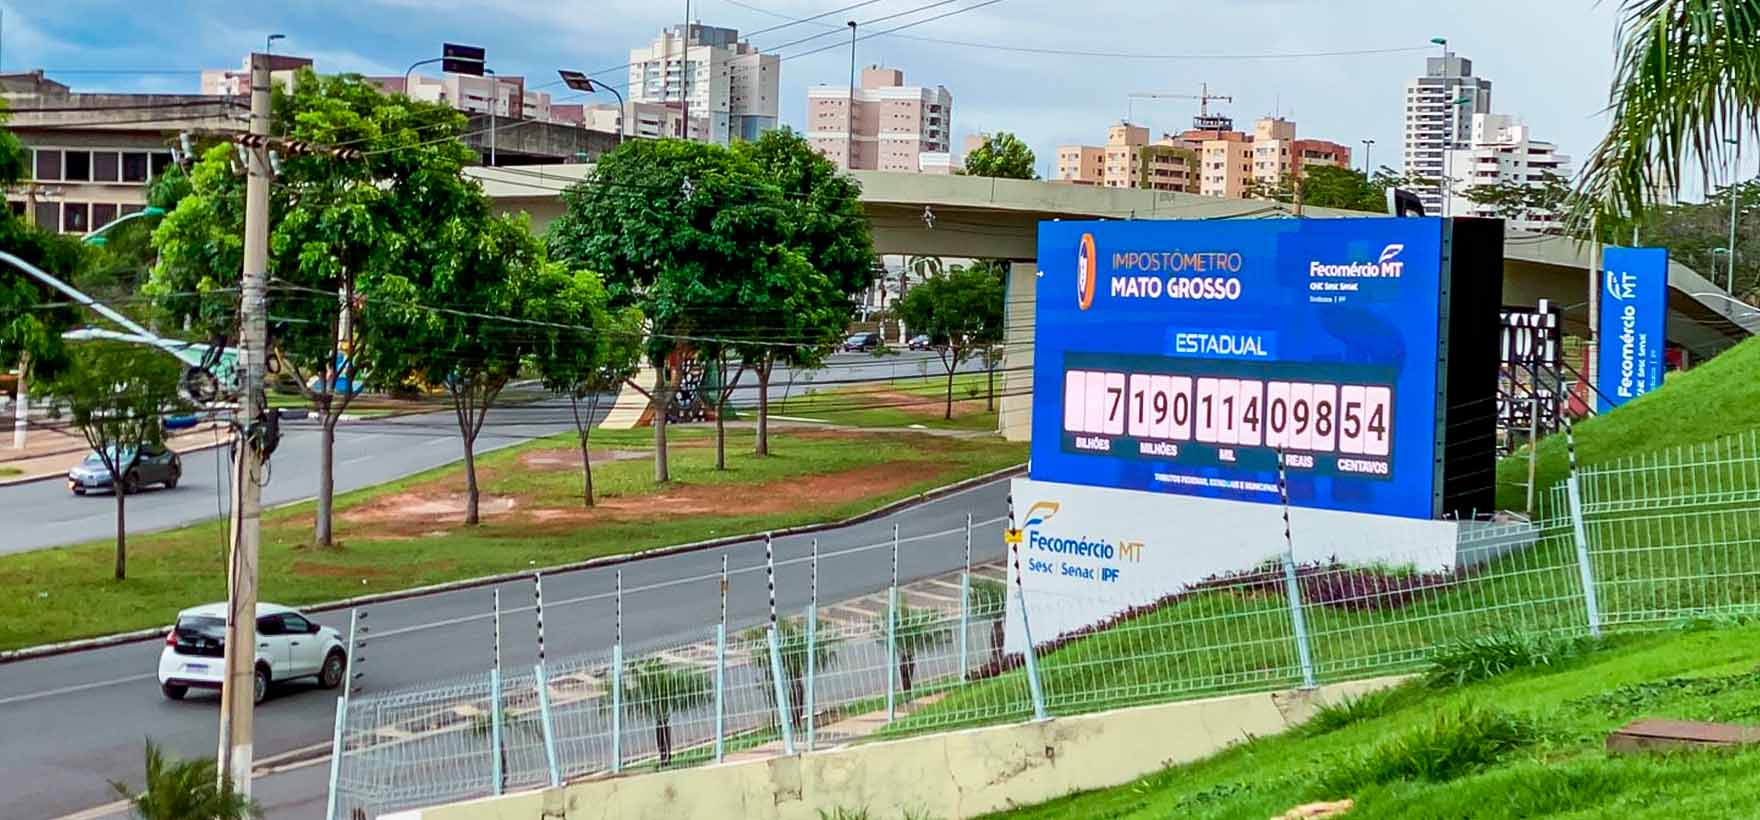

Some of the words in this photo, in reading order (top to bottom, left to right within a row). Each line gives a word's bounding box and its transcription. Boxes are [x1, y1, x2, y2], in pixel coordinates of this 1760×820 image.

[1112, 249, 1242, 272] IMPOSTÔMETRO
[1310, 261, 1380, 277] Fecomércio
[1381, 261, 1404, 278] MT
[1111, 276, 1162, 298] MATO
[1167, 277, 1241, 300] GROSSO
[1621, 271, 1637, 299] MT
[1176, 333, 1268, 356] ESTADUAL
[1617, 305, 1636, 397] Fecomércio
[1107, 387, 1122, 421] 7
[1134, 390, 1189, 426] 190
[1202, 394, 1259, 432] 114
[1271, 398, 1332, 437] 098
[1343, 402, 1386, 441] 54
[1075, 435, 1110, 451] BILHÕES
[1139, 441, 1178, 456] MILHÕES
[1285, 454, 1314, 468] REAIS
[1337, 458, 1388, 474] CENTAVOS
[1029, 530, 1114, 559] Fecomércio
[1119, 541, 1145, 563] MT
[1028, 558, 1053, 573] Sesc
[1061, 562, 1095, 580] Senac
[1101, 567, 1120, 583] IPF
